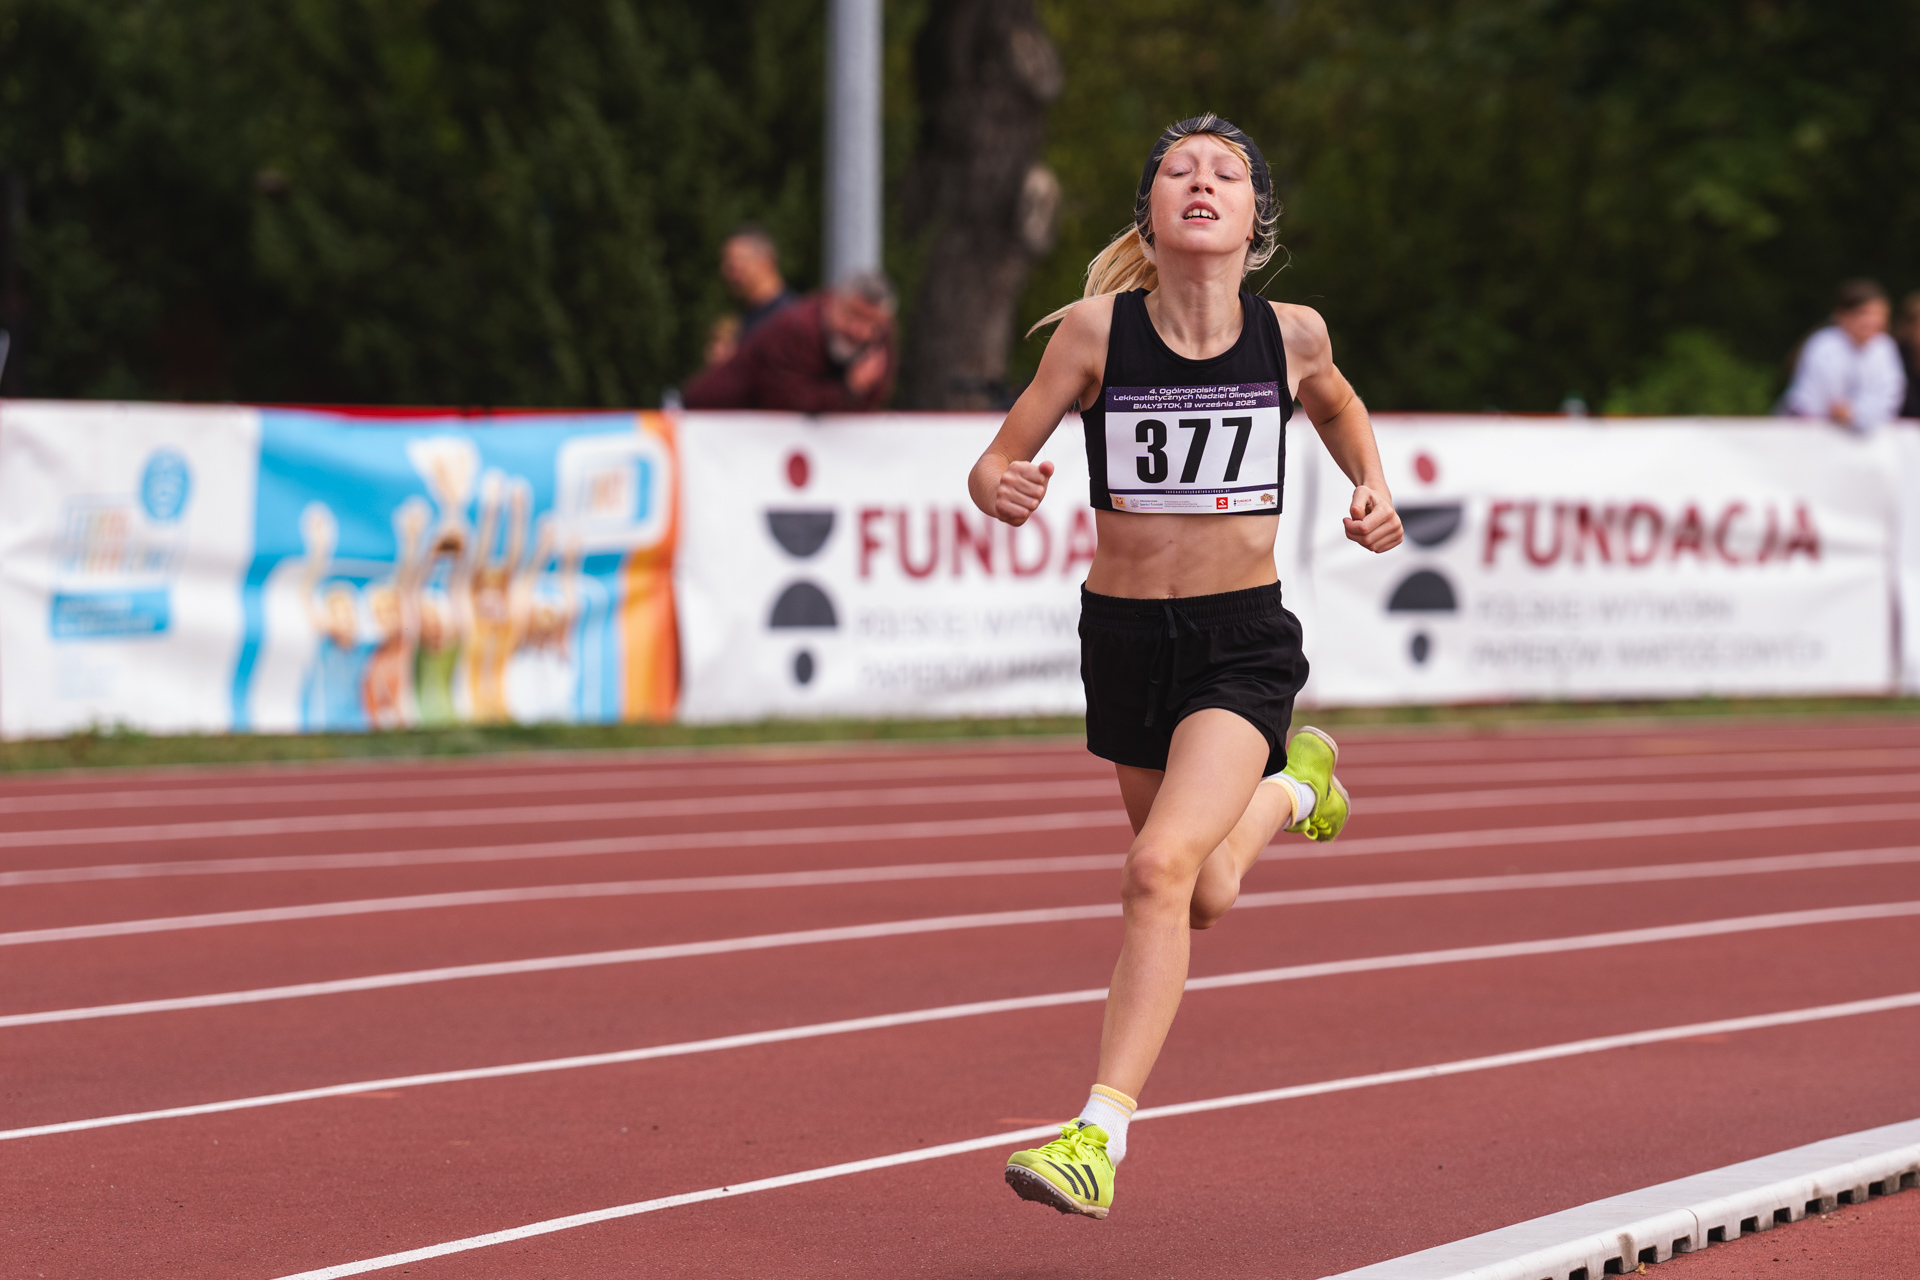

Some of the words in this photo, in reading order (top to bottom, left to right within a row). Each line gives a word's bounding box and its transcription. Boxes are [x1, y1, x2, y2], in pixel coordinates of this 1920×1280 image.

[1113, 394, 1194, 402] Lekkoatletycznych
[1228, 390, 1273, 399] Olimpijskich
[1160, 387, 1216, 395] Ogólnopolski
[1194, 400, 1234, 408] września
[1235, 399, 1257, 407] 2025
[1135, 416, 1253, 484] 377
[857, 506, 1097, 580] FUNDA
[1481, 498, 1823, 568] FUNDACJA
